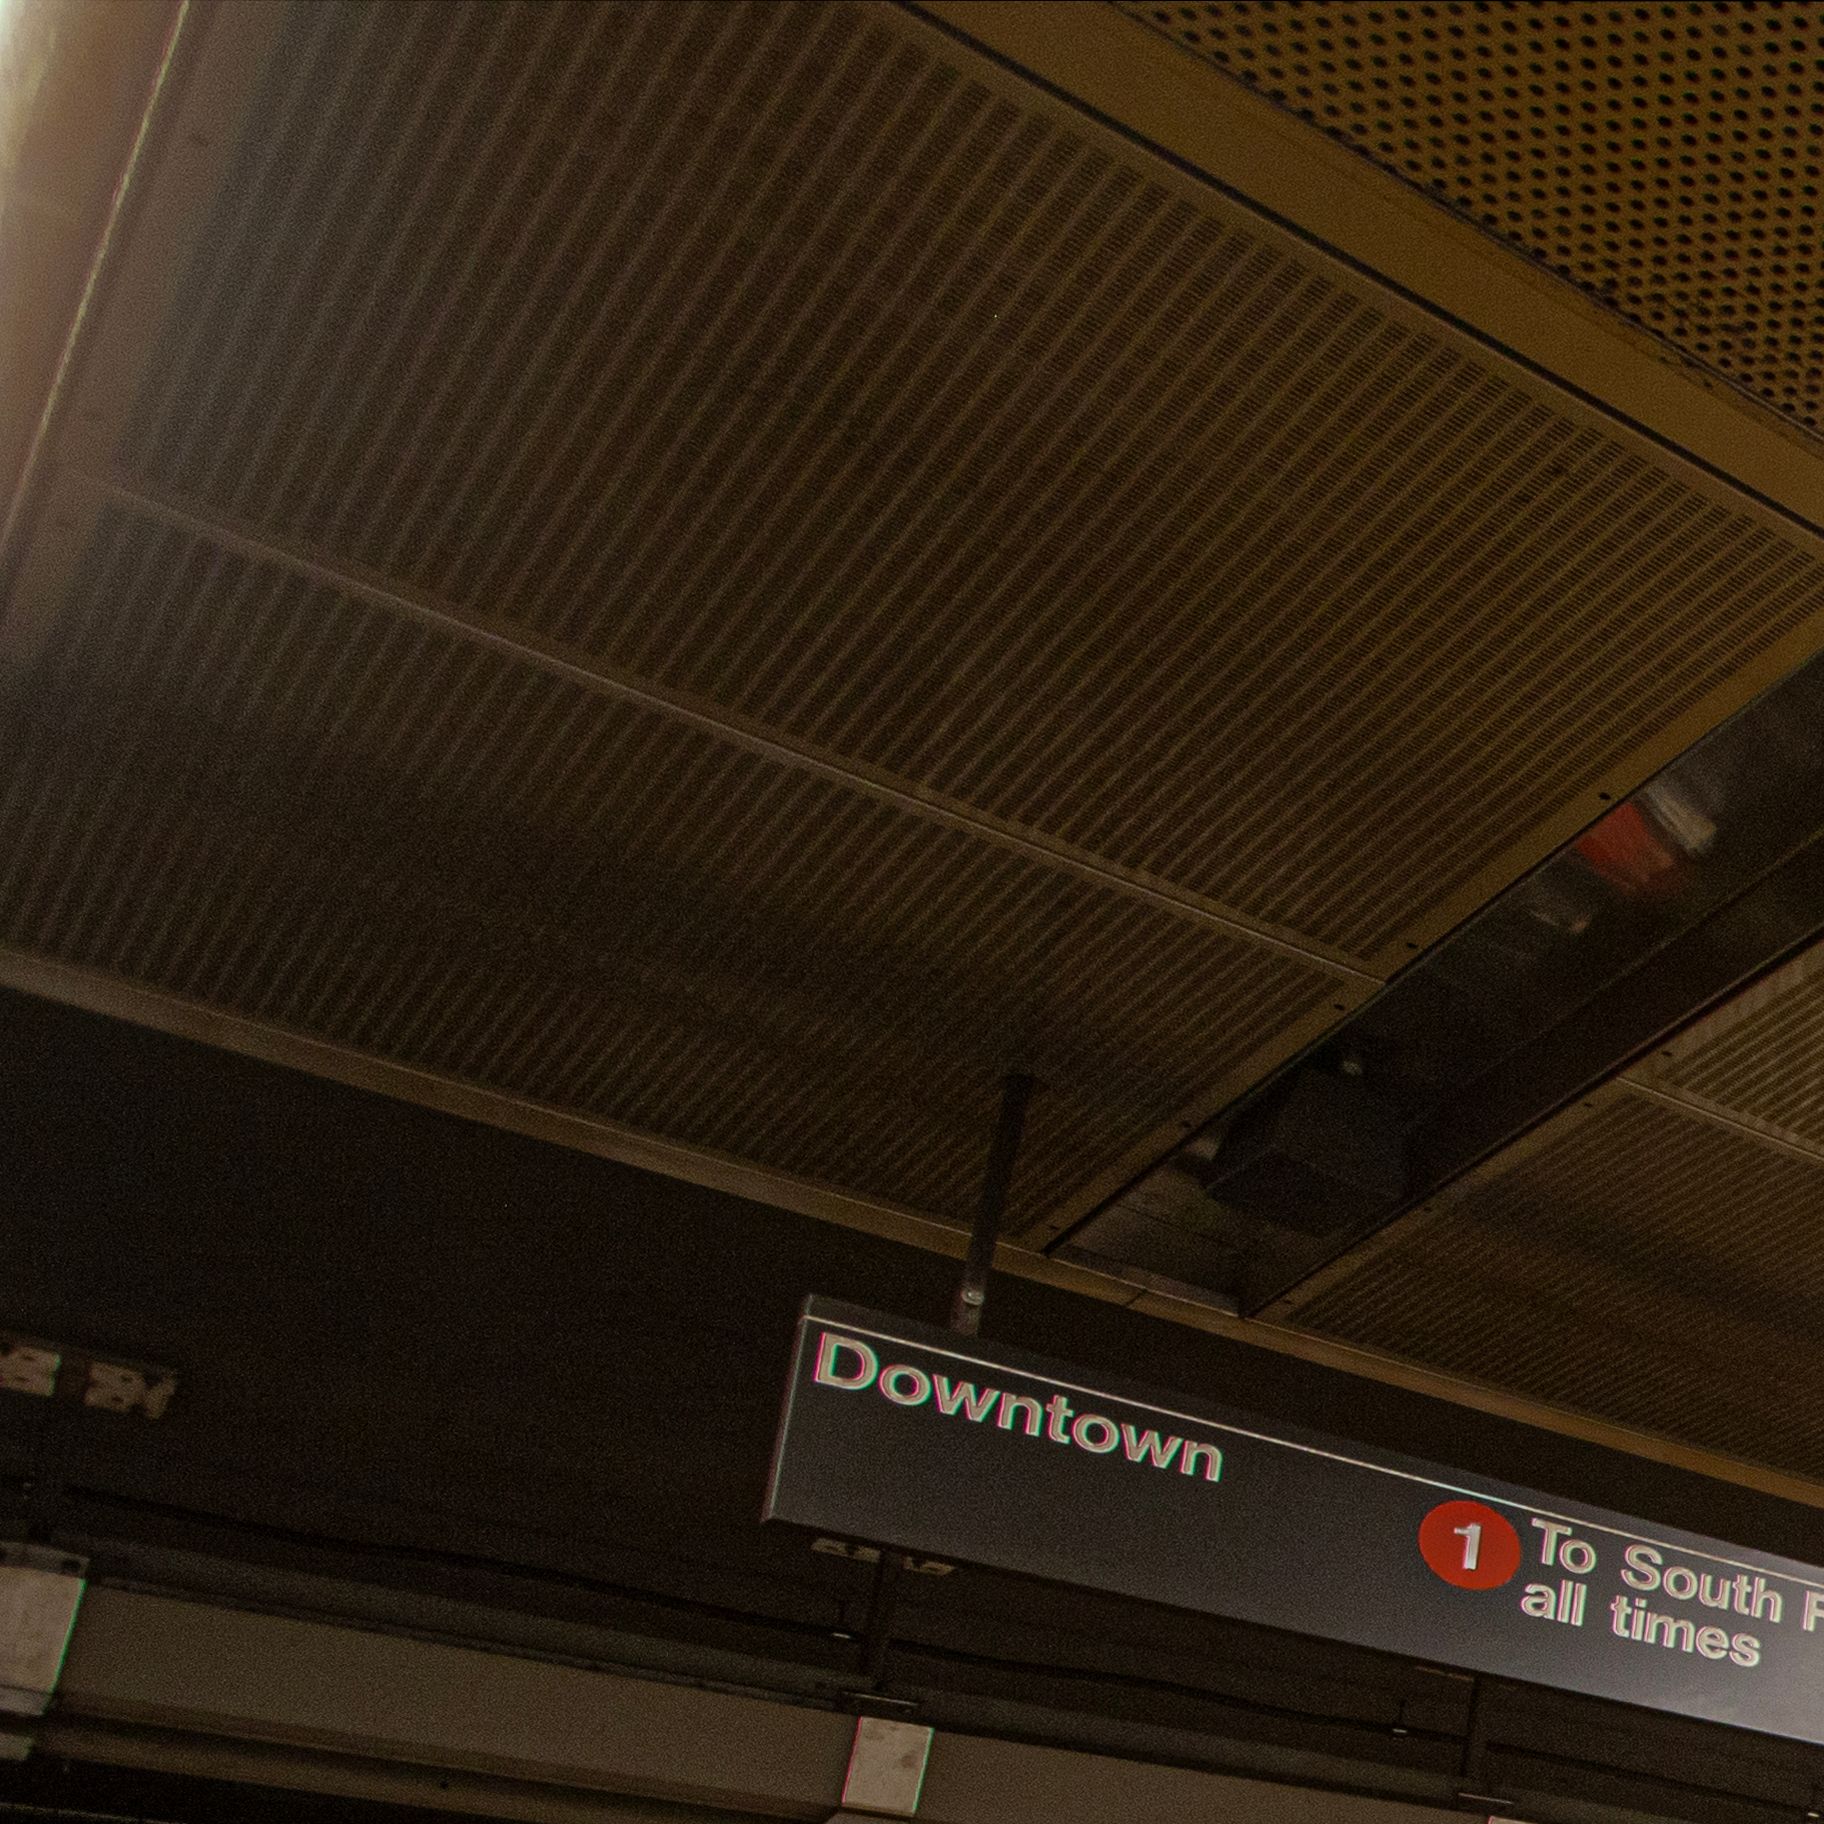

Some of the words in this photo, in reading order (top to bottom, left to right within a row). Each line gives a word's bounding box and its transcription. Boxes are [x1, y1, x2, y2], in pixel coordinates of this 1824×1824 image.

[813, 1331, 1224, 1483] Downtown
[1448, 1522, 1482, 1571] 1
[1531, 1517, 1597, 1576] To
[1619, 1544, 1784, 1625] South
[1519, 1578, 1589, 1628] all
[1609, 1593, 1764, 1670] times
